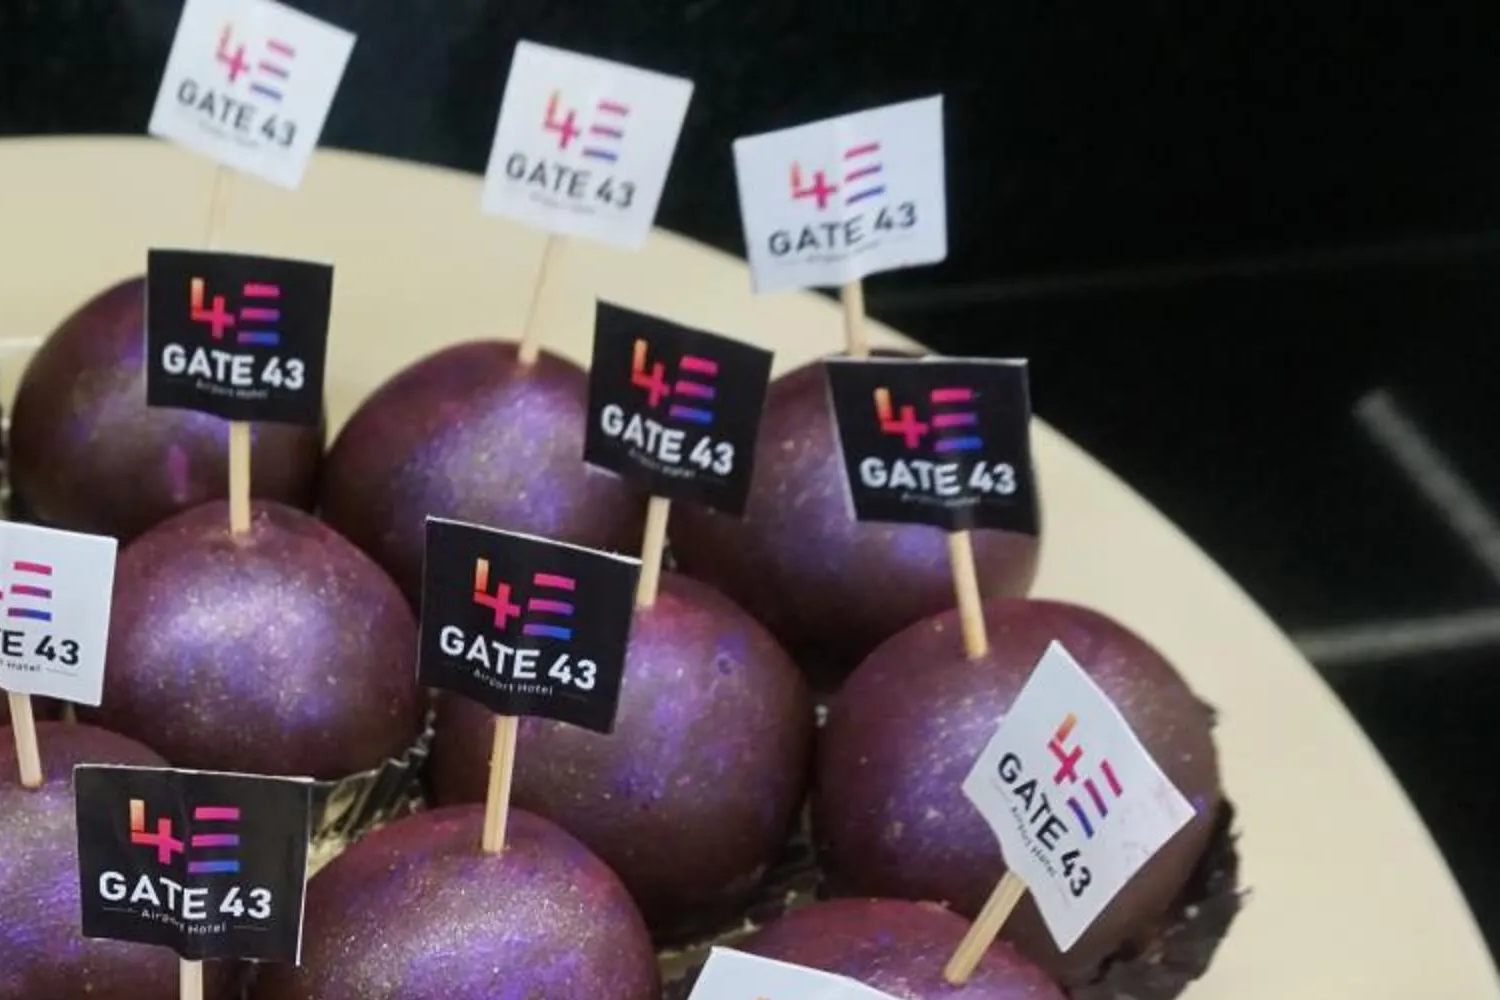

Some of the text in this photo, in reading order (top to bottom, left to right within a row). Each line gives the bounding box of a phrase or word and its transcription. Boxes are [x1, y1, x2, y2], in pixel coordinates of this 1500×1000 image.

[176, 77, 257, 130] GATE
[261, 116, 297, 147] 43
[505, 154, 592, 198] GATE
[596, 176, 636, 210] 43
[768, 218, 864, 257] GATE
[873, 202, 917, 231] 43
[162, 344, 305, 389] GATE 43
[600, 404, 686, 462] GATE
[689, 436, 734, 475] 43
[860, 457, 1016, 495] GATE 43
[35, 635, 80, 665] 43
[440, 626, 597, 689] GATE 43
[518, 682, 553, 695] Hotel
[998, 753, 1092, 897] GATE 43
[98, 871, 272, 919] GATE 43
[187, 922, 227, 935] Hotel
